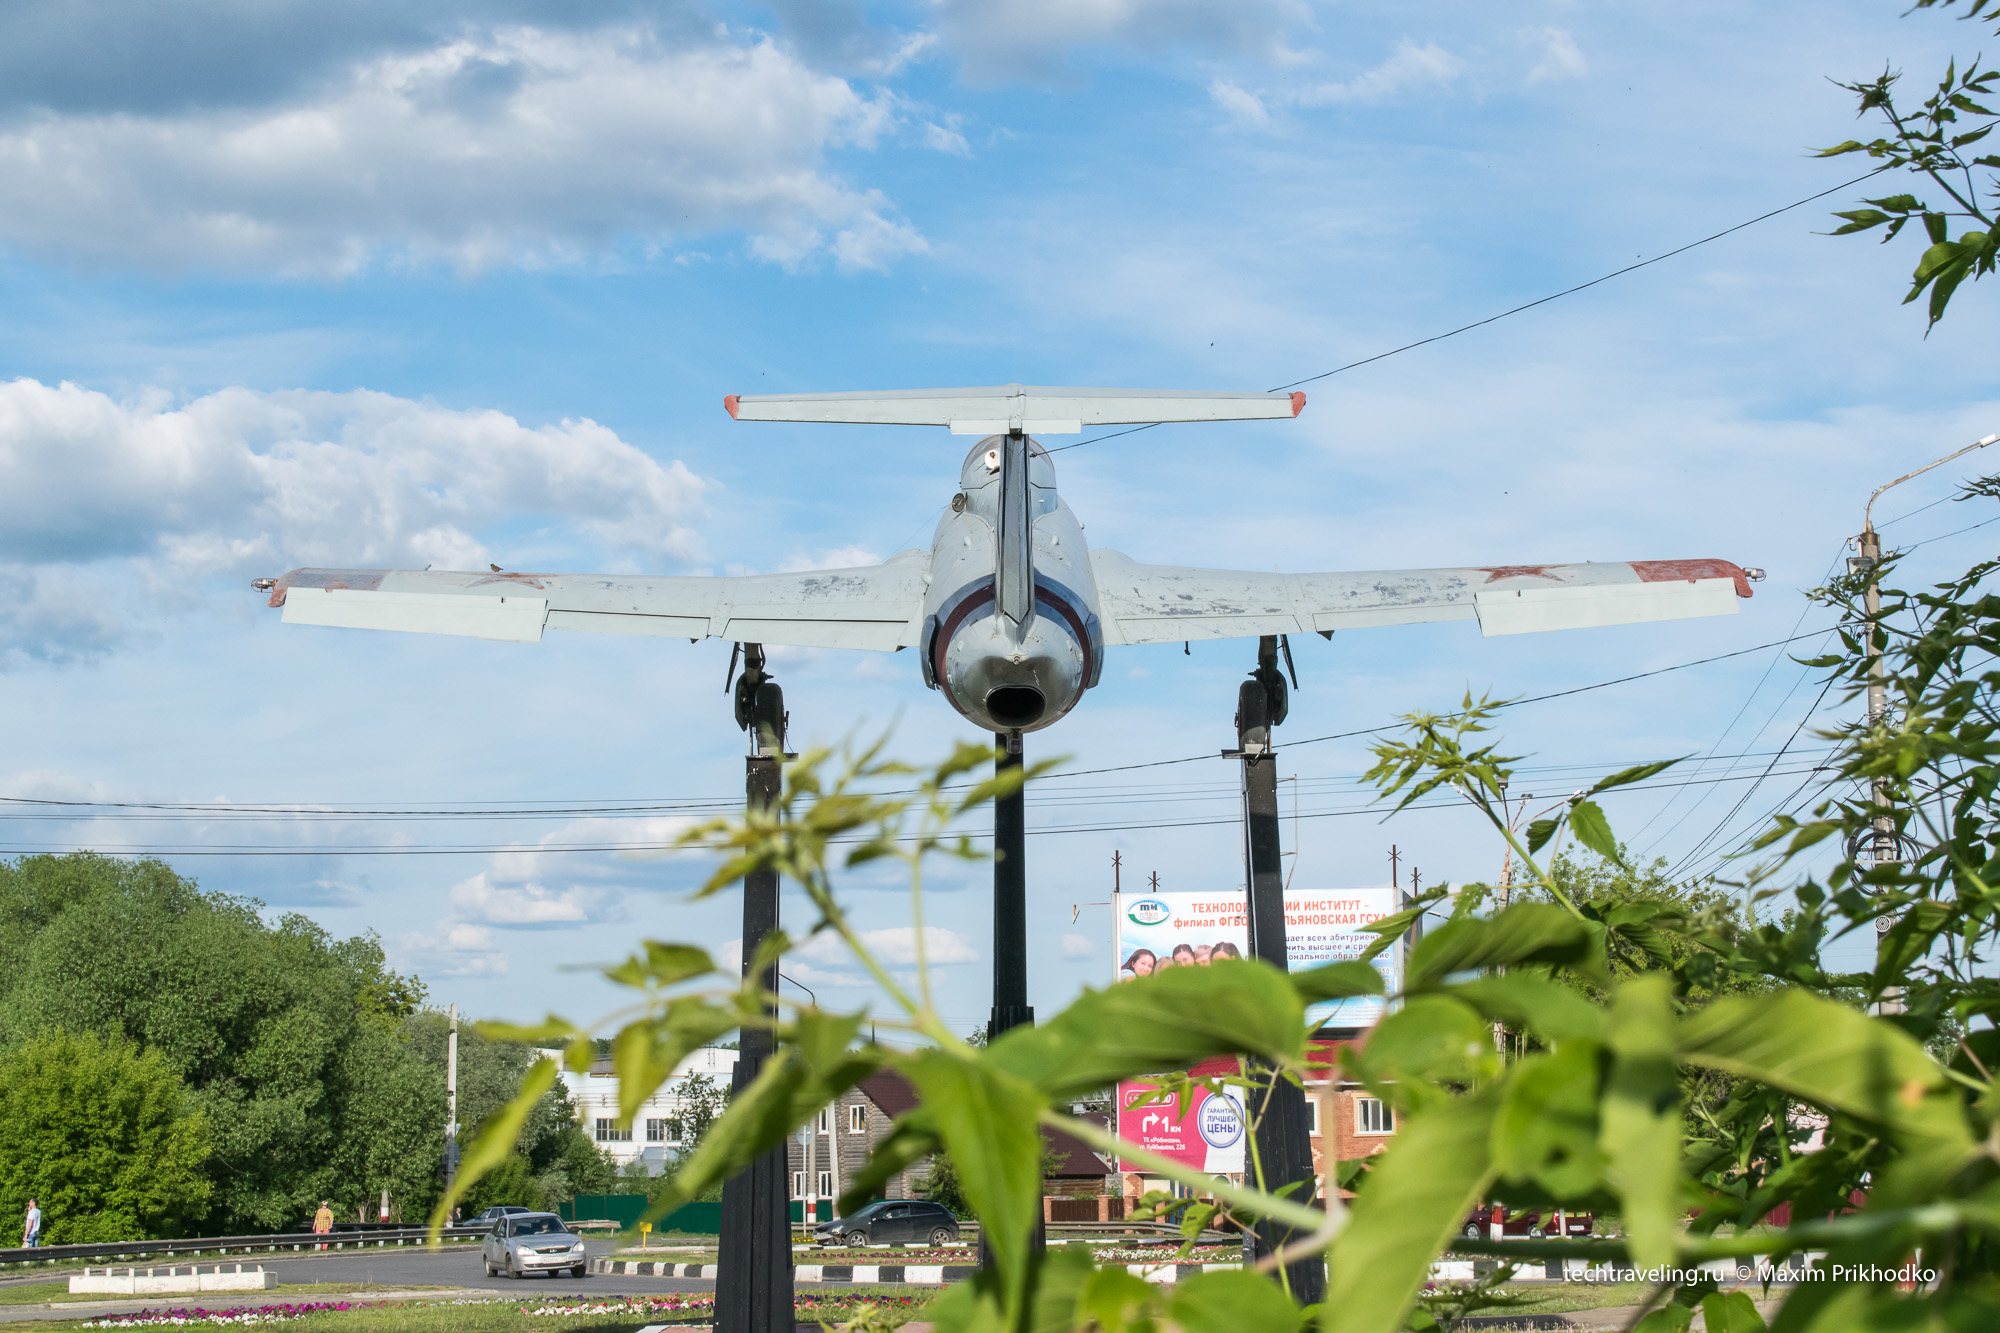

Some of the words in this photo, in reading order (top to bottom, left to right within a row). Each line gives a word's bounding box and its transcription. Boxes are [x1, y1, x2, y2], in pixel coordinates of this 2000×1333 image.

[1192, 902, 1247, 913] ТЕХНОЛОГ
[1304, 899, 1361, 911] ИНСТИТУТ
[1174, 917, 1215, 930] филиал
[1219, 916, 1248, 927] ФГБО
[1284, 913, 1356, 925] ЛЬЯНОВСКАЯ
[1329, 933, 1382, 943] абитуриент
[1308, 943, 1342, 951] высшее
[1288, 952, 1330, 960] ональное
[1161, 1116, 1169, 1133] 1
[1207, 1124, 1236, 1134] ЦЕНЫ
